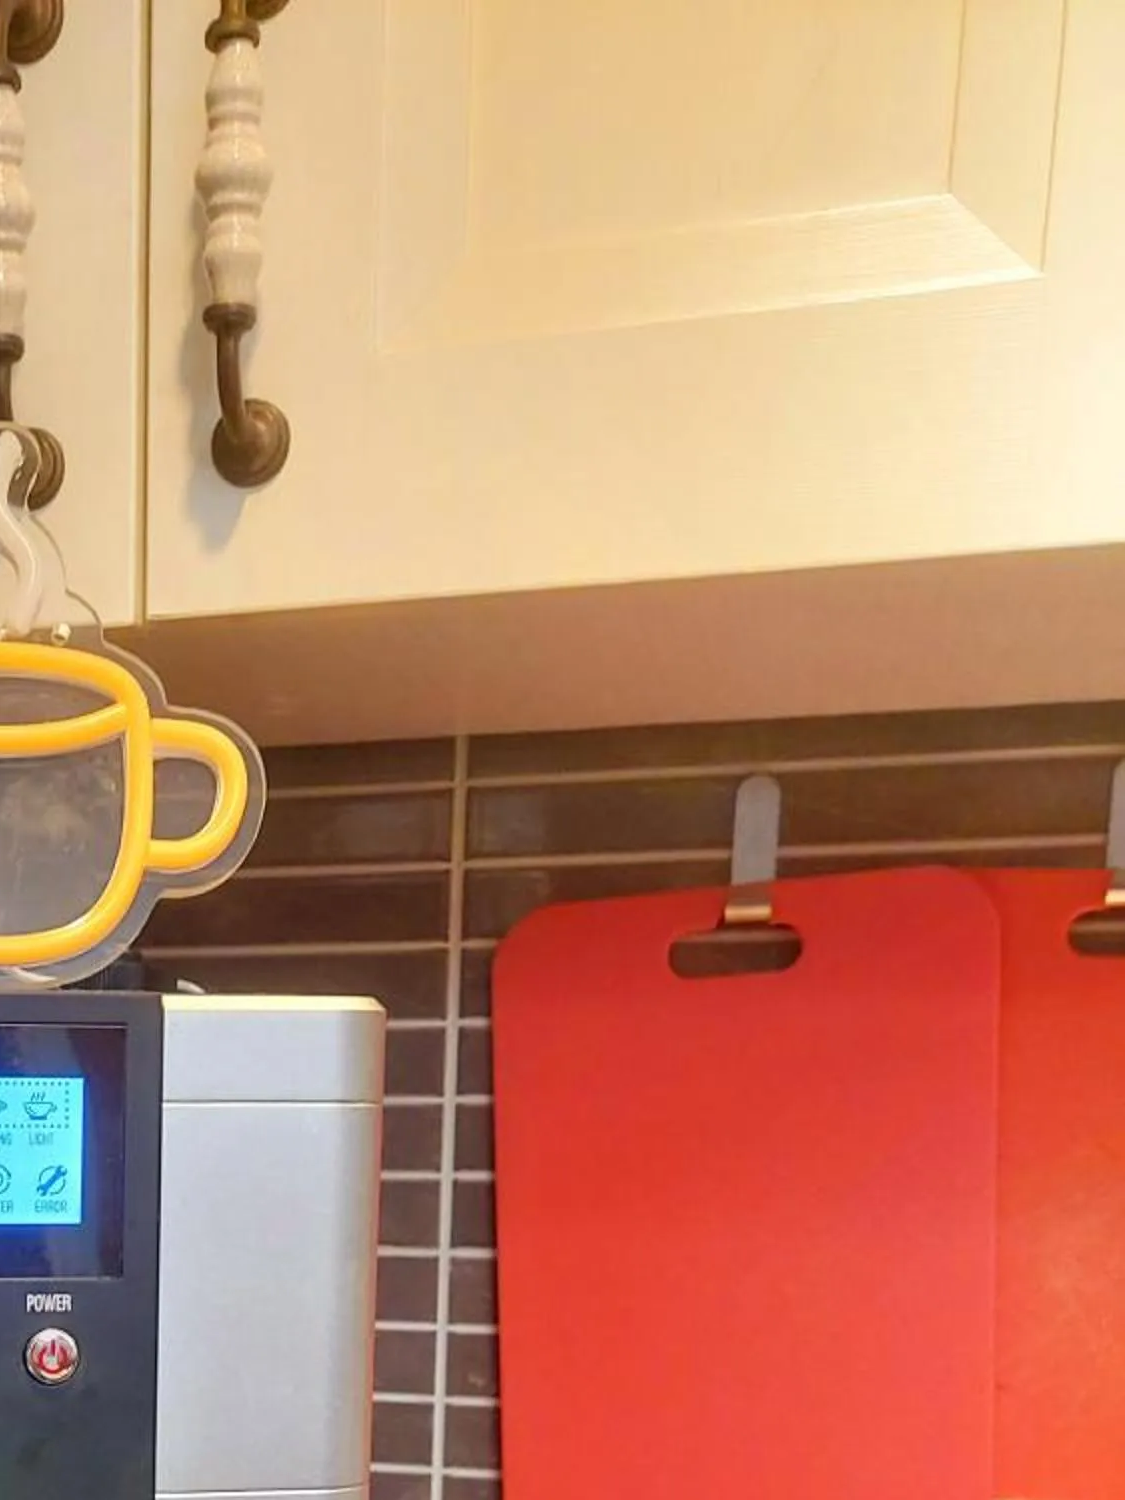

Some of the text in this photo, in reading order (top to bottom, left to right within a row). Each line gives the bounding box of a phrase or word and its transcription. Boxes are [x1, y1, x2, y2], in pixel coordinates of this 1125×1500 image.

[28, 1132, 55, 1146] LIGHT
[33, 1199, 68, 1214] ERROR
[25, 1293, 73, 1313] POWER
